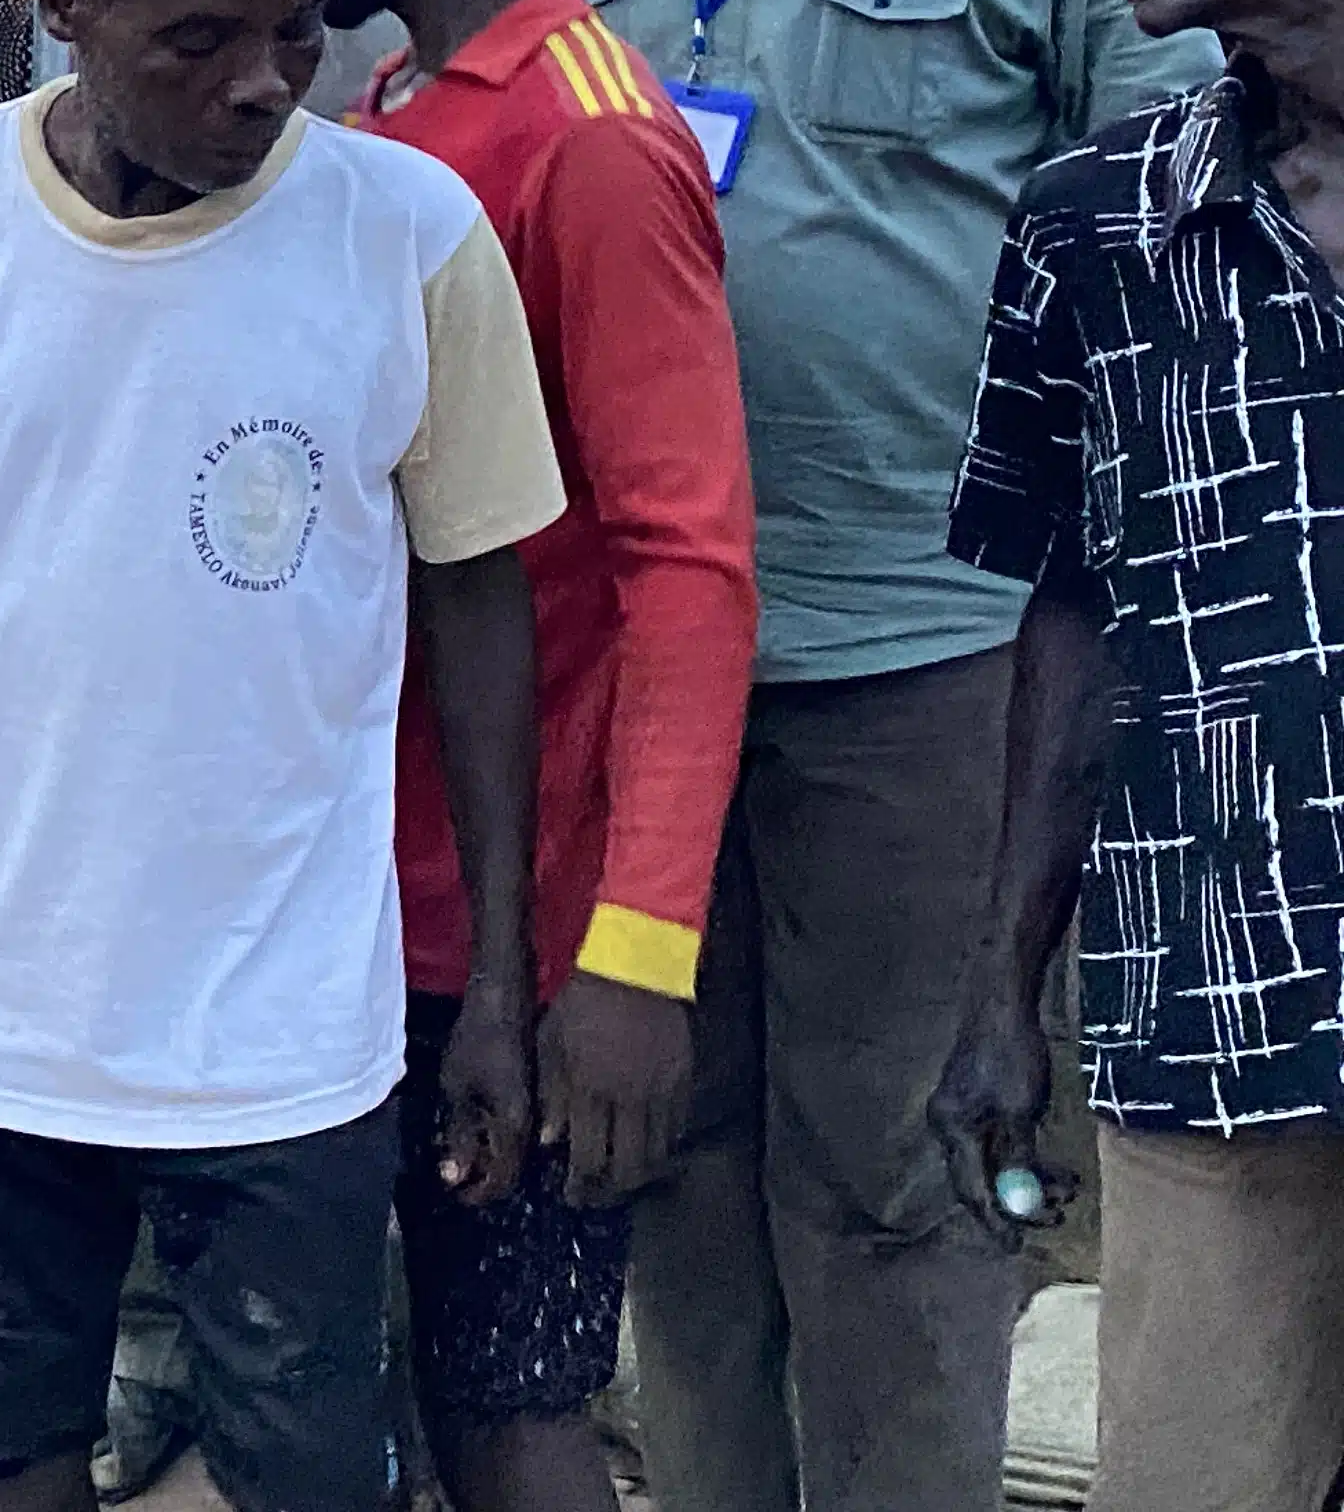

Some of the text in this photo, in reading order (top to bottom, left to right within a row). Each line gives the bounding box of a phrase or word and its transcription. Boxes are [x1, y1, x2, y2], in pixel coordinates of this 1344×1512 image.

[202, 416, 325, 474] En Mémoire de
[189, 492, 224, 573] TAMEKLO
